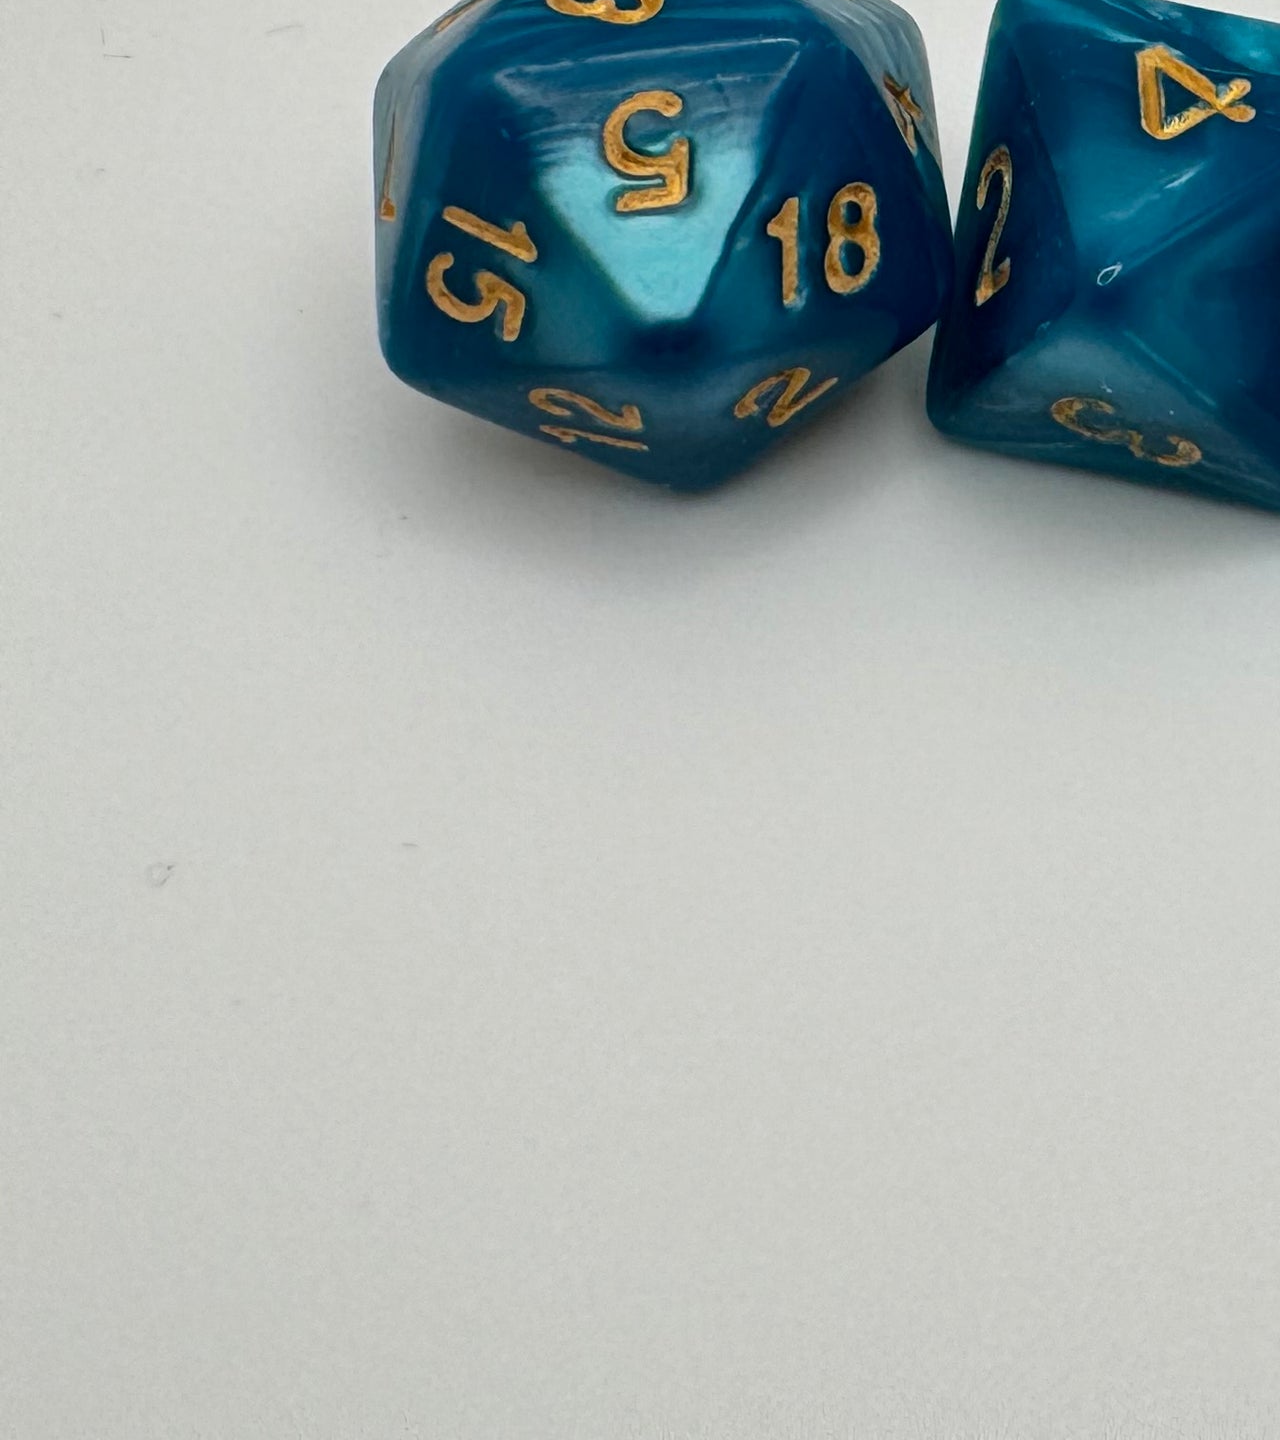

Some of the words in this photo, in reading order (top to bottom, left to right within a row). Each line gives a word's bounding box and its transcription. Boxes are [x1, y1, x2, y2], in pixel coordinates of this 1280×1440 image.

[601, 88, 691, 214] 5
[1135, 44, 1257, 142] 4
[425, 205, 539, 343] 15
[765, 181, 881, 308] 18
[975, 144, 1014, 307] 2
[733, 366, 839, 428] 2
[1050, 396, 1203, 468] 3
